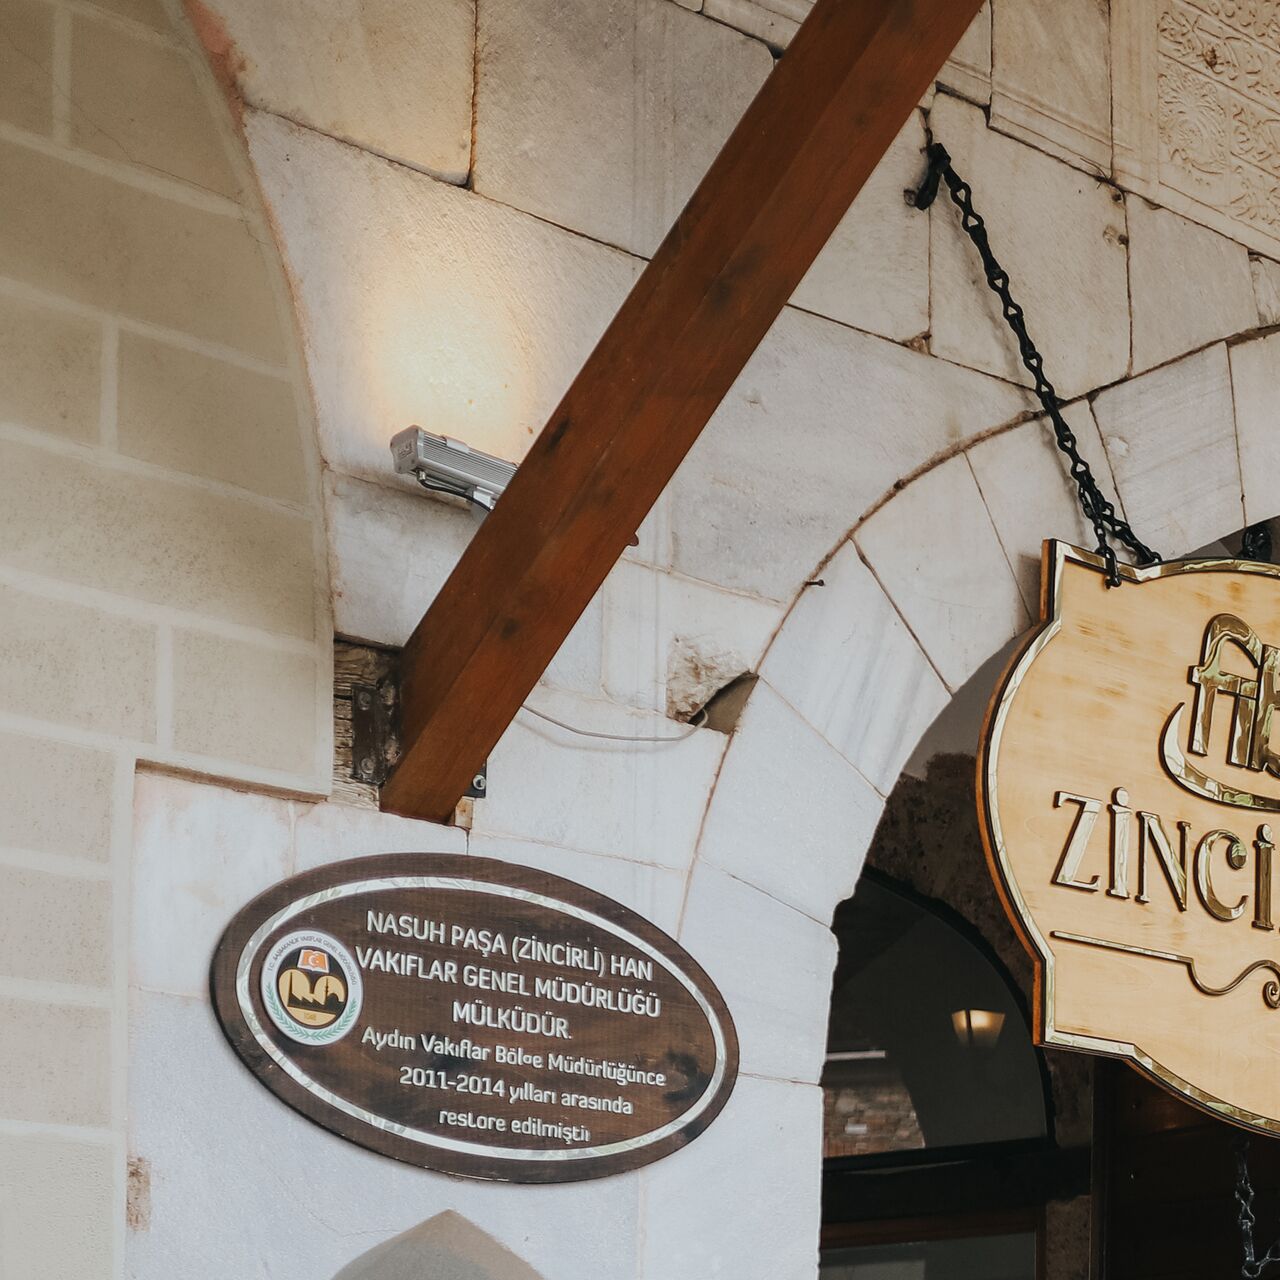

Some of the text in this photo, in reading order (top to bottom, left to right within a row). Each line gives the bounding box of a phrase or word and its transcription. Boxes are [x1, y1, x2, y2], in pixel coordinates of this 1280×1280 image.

[367, 910, 653, 982] NASUH PAŞA (ZİNCİRLİ) HAN
[355, 946, 661, 1018] VAKIFLAR GENEL MÜDÜRLÜĞÜ
[452, 999, 572, 1039] MÜLKÜDÜR.
[361, 1026, 416, 1051] Aydın
[420, 1033, 491, 1061] Vakıflar
[548, 1053, 667, 1086] Müdürlüğünce
[399, 1066, 633, 1115] 2011-2014 yılları arasında
[439, 1110, 507, 1132] restore
